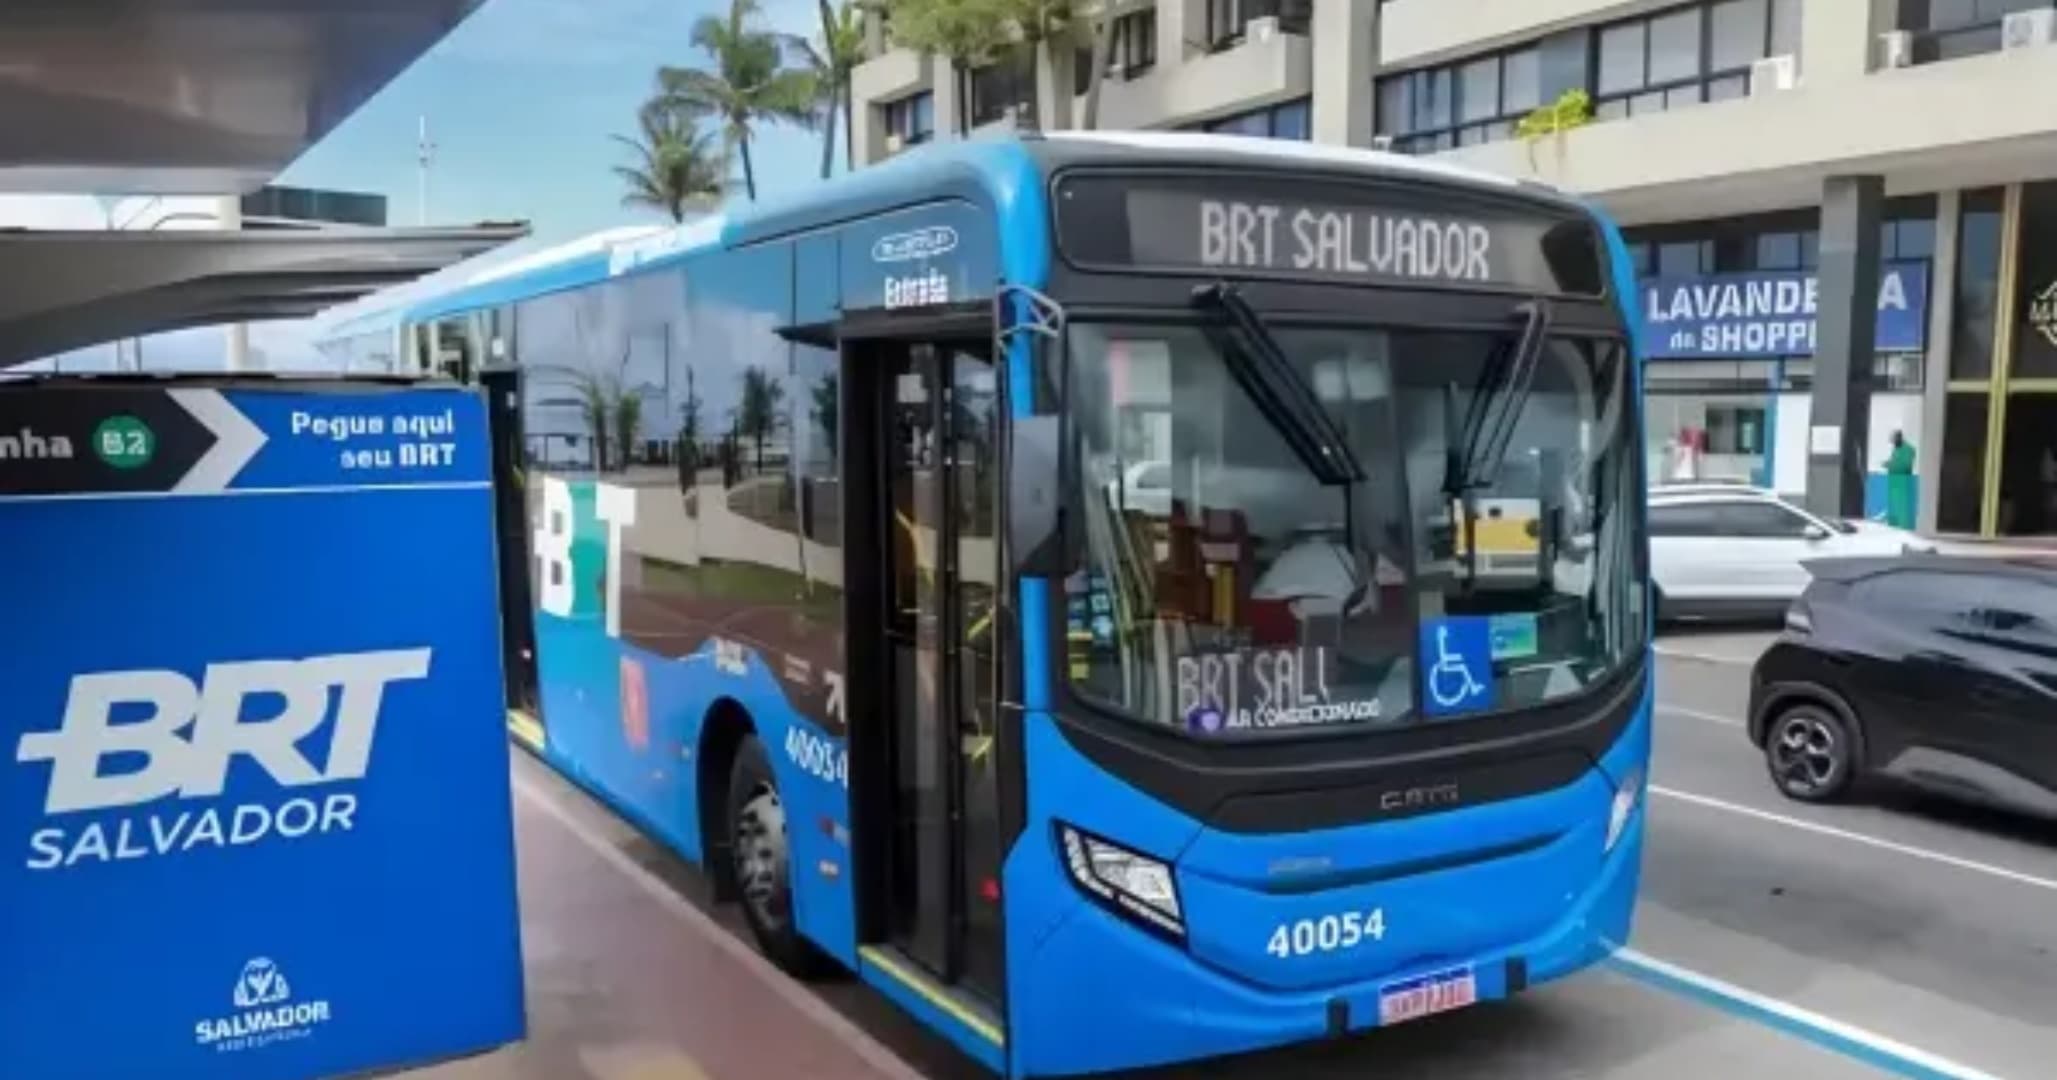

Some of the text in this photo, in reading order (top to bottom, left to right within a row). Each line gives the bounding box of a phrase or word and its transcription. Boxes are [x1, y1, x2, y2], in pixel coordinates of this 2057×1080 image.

[1200, 201, 1491, 281] BRT SALVADOR
[1648, 271, 1907, 322] LAVANDEA
[1701, 319, 1817, 352] SHOPPI
[102, 430, 147, 456] B2
[291, 408, 453, 441] Pegue aqui
[399, 443, 455, 467] BRT
[1177, 651, 1243, 727] BRT
[16, 647, 432, 814] BRT
[26, 794, 357, 870] SALVADOR
[1266, 907, 1386, 958] 40054
[195, 1000, 331, 1044] SALVADOR
